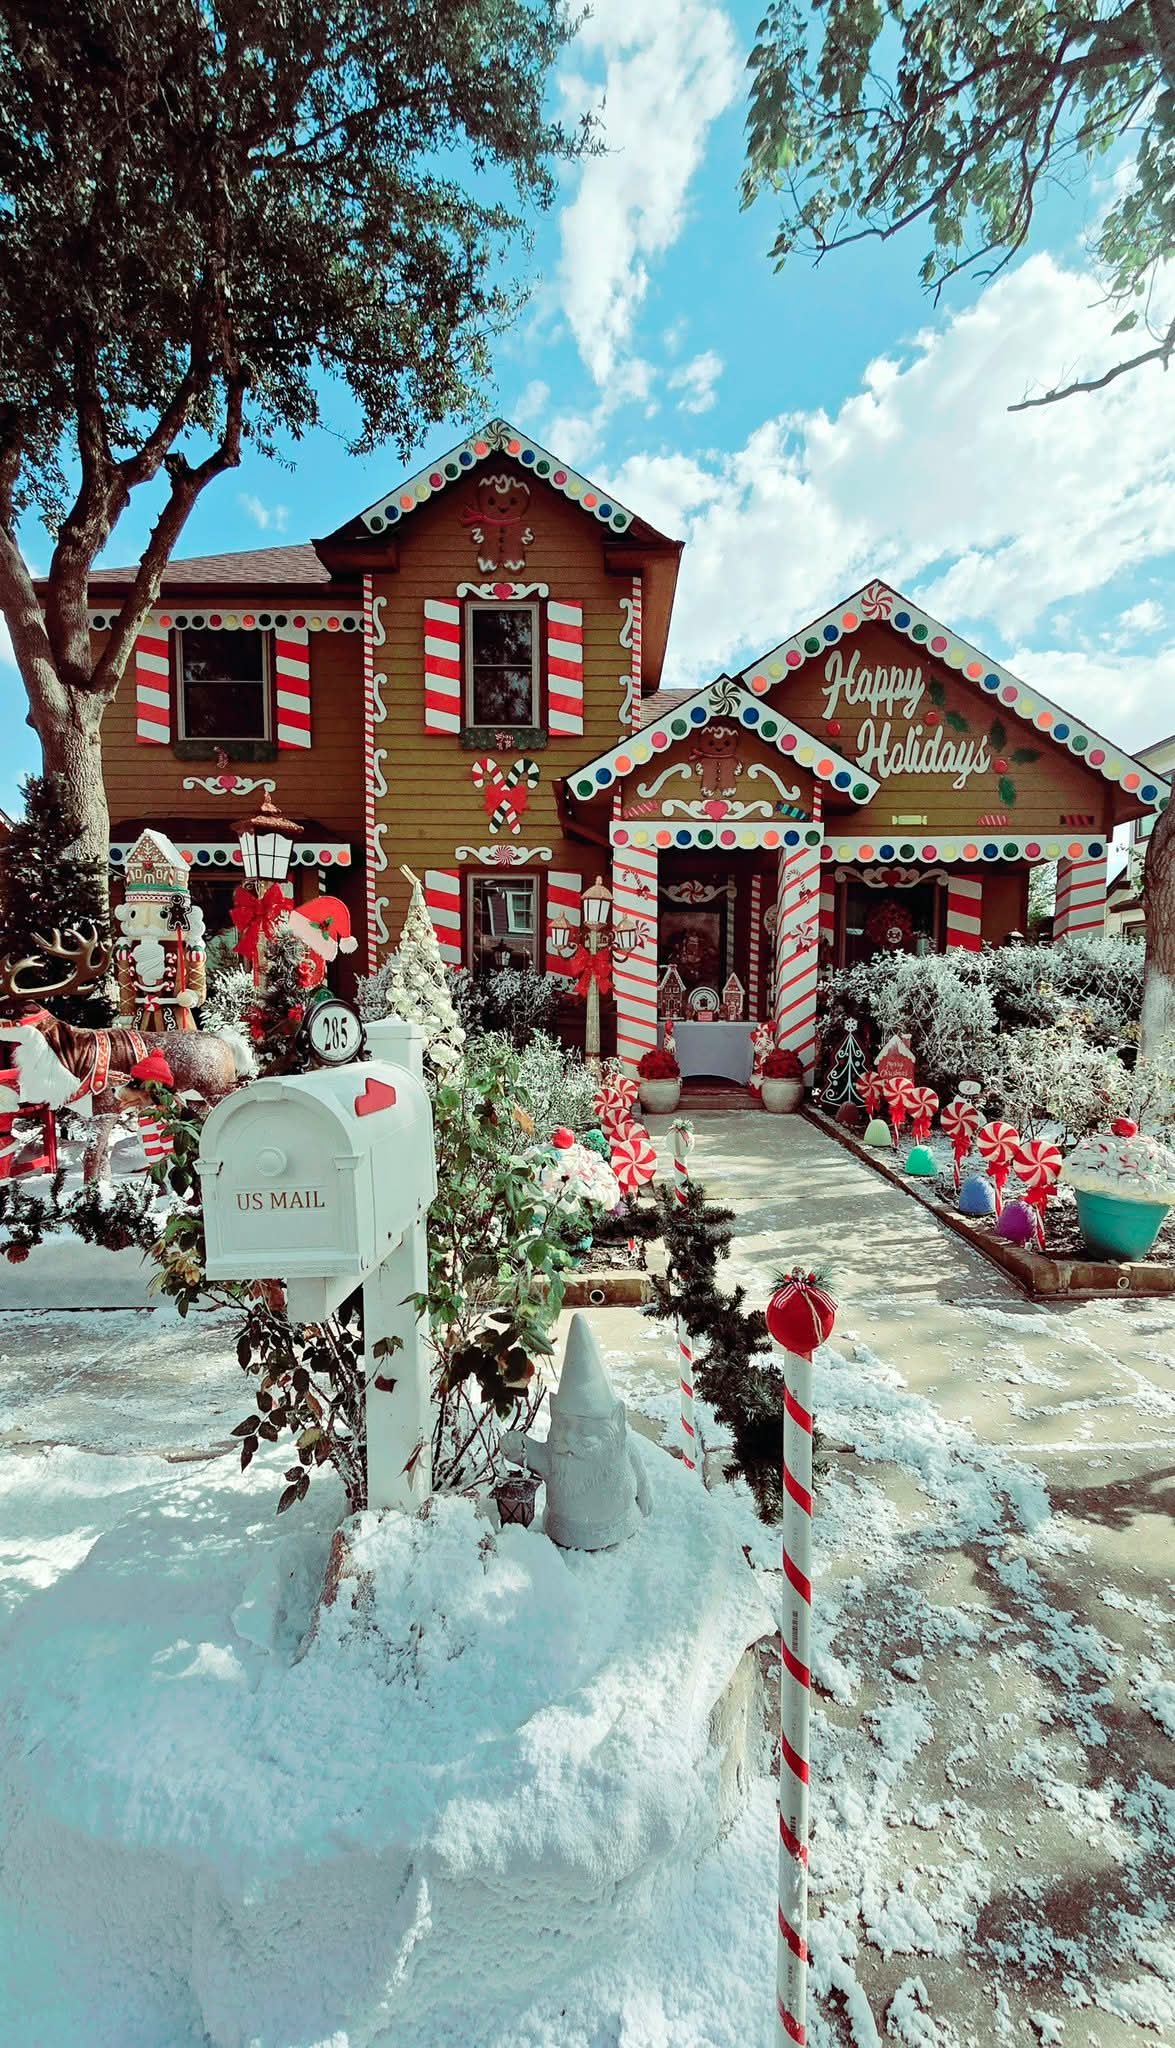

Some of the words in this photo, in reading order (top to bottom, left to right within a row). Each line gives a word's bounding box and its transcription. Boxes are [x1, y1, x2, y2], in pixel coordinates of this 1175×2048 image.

[822, 649, 925, 720] Happy
[856, 718, 991, 790] Holidays
[322, 1016, 348, 1051] 285
[236, 1192, 264, 1211] US
[270, 1190, 326, 1209] MAIL
